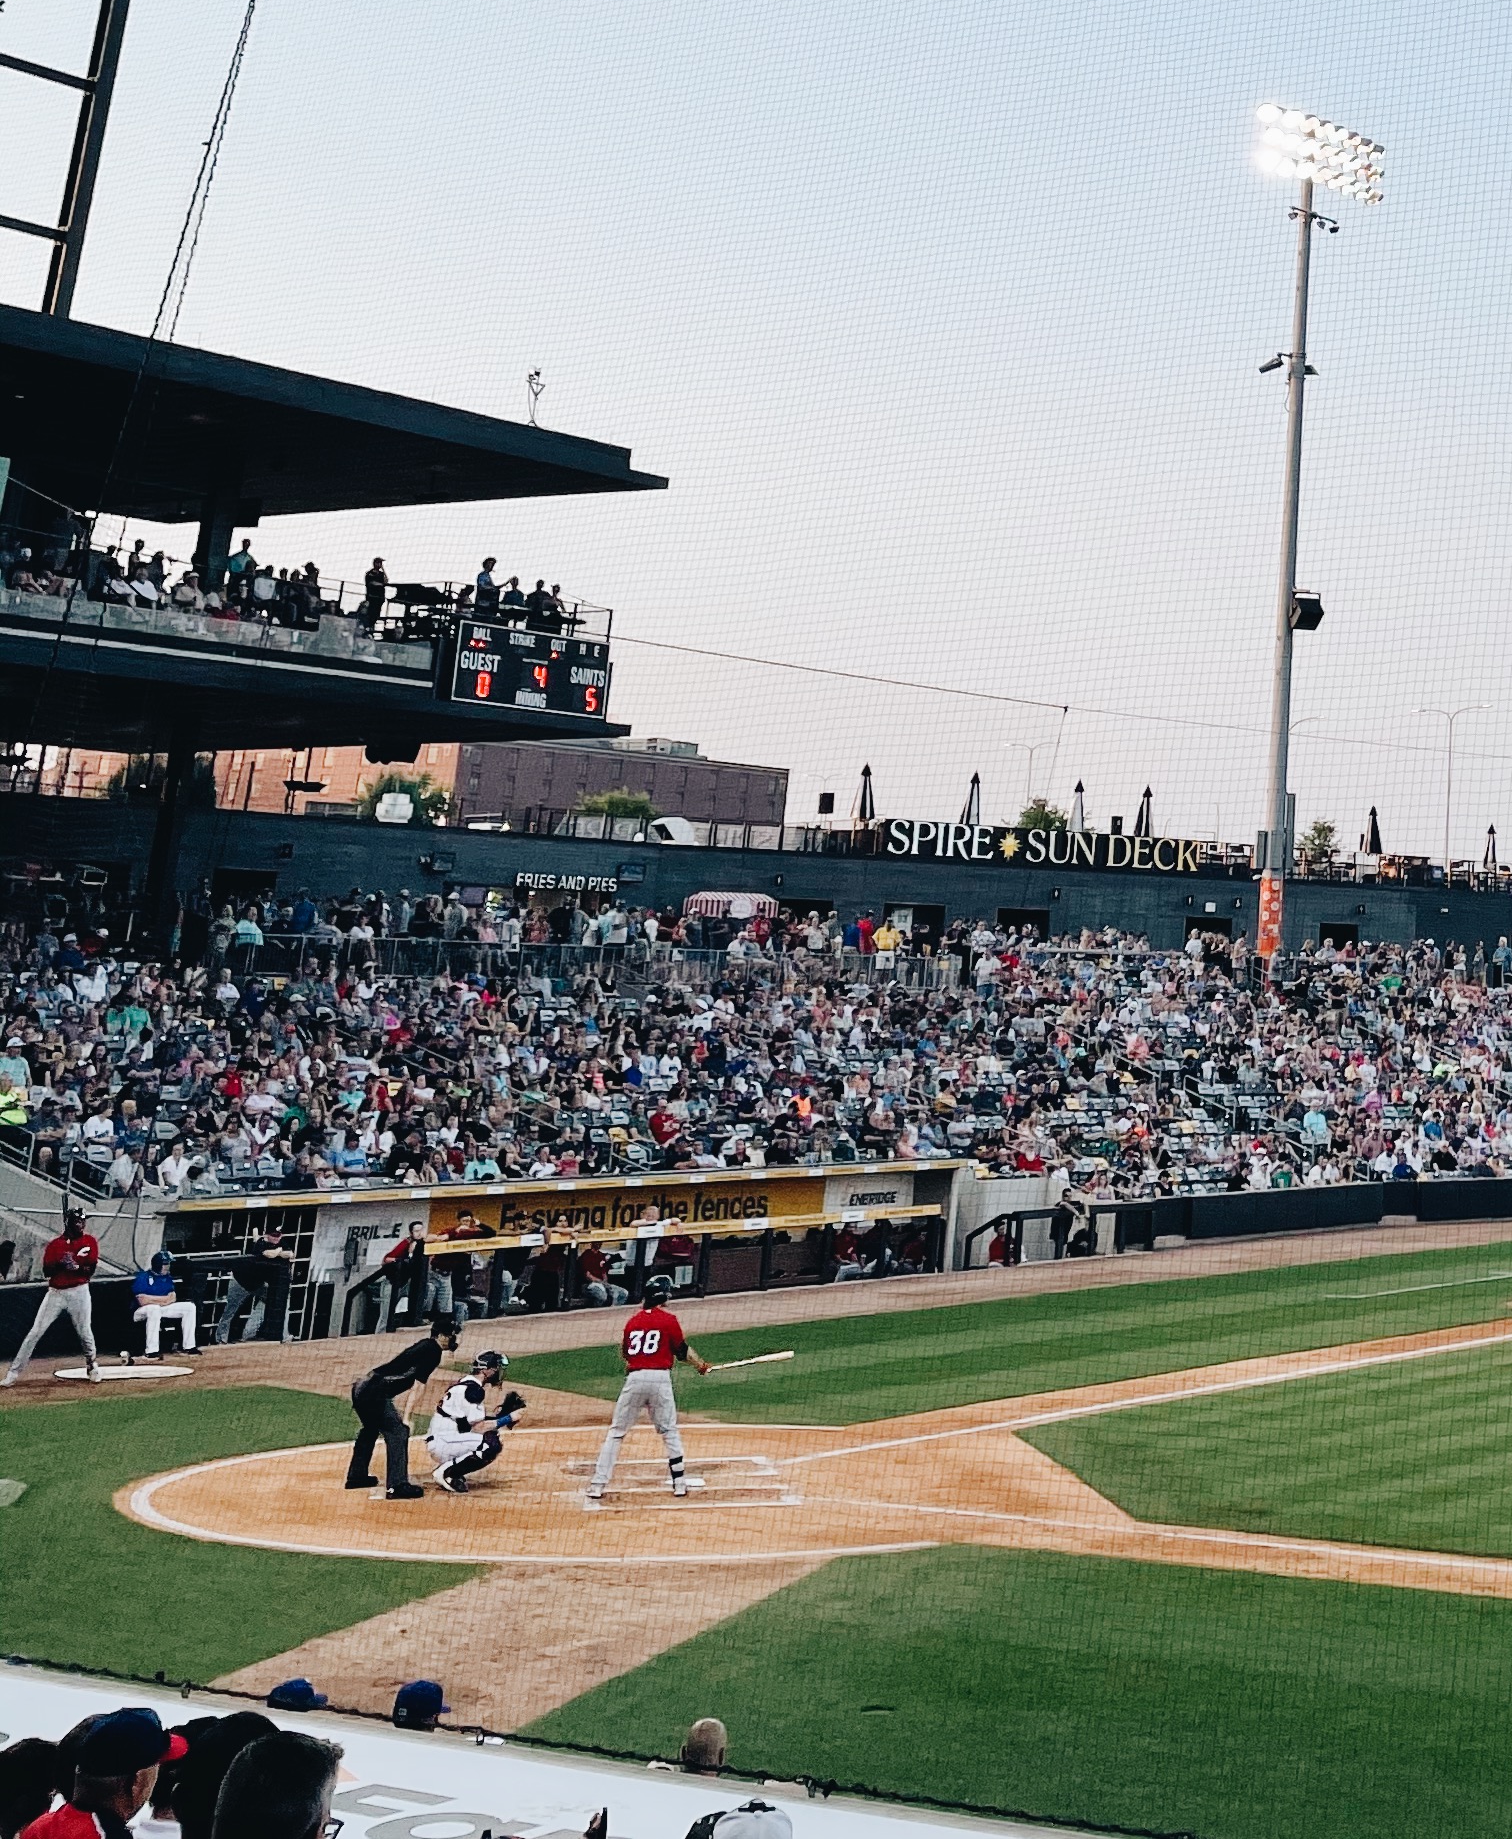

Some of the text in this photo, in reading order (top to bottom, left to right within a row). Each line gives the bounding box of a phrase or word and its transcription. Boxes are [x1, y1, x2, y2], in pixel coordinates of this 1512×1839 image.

[509, 632, 536, 647] STRIKE
[551, 639, 567, 652] OUT
[460, 651, 501, 673] GUEST
[533, 665, 548, 688] 4
[570, 667, 606, 687] SAINTS
[515, 691, 547, 708] INNING
[585, 686, 598, 712] 5
[887, 820, 1200, 871] SPIRE SUN DECK
[516, 873, 617, 892] FRIES AND PIES
[693, 1192, 768, 1221] fences
[627, 1329, 661, 1355] 38
